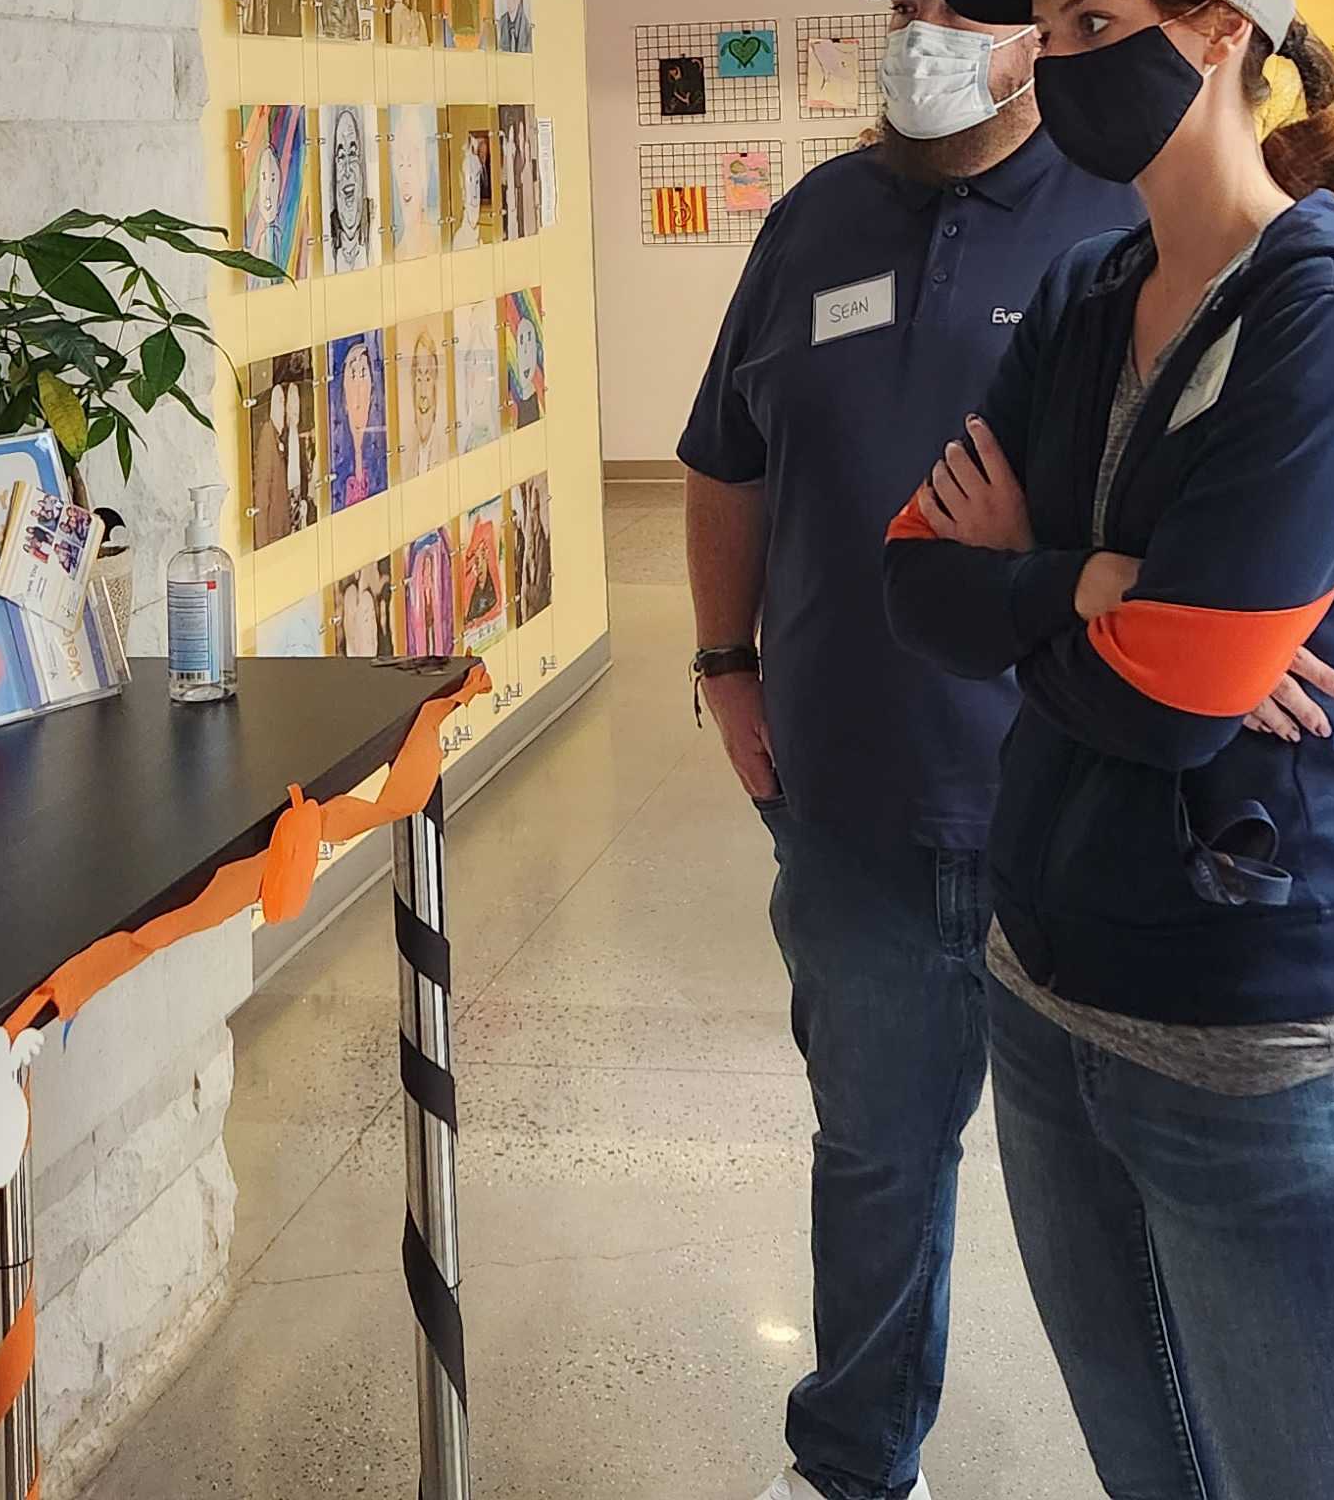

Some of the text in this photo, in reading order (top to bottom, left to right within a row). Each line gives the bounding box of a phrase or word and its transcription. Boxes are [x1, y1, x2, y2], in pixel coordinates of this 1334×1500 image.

[829, 296, 870, 324] SEAN
[991, 307, 1023, 325] Eve
[62, 627, 84, 681] Welc
